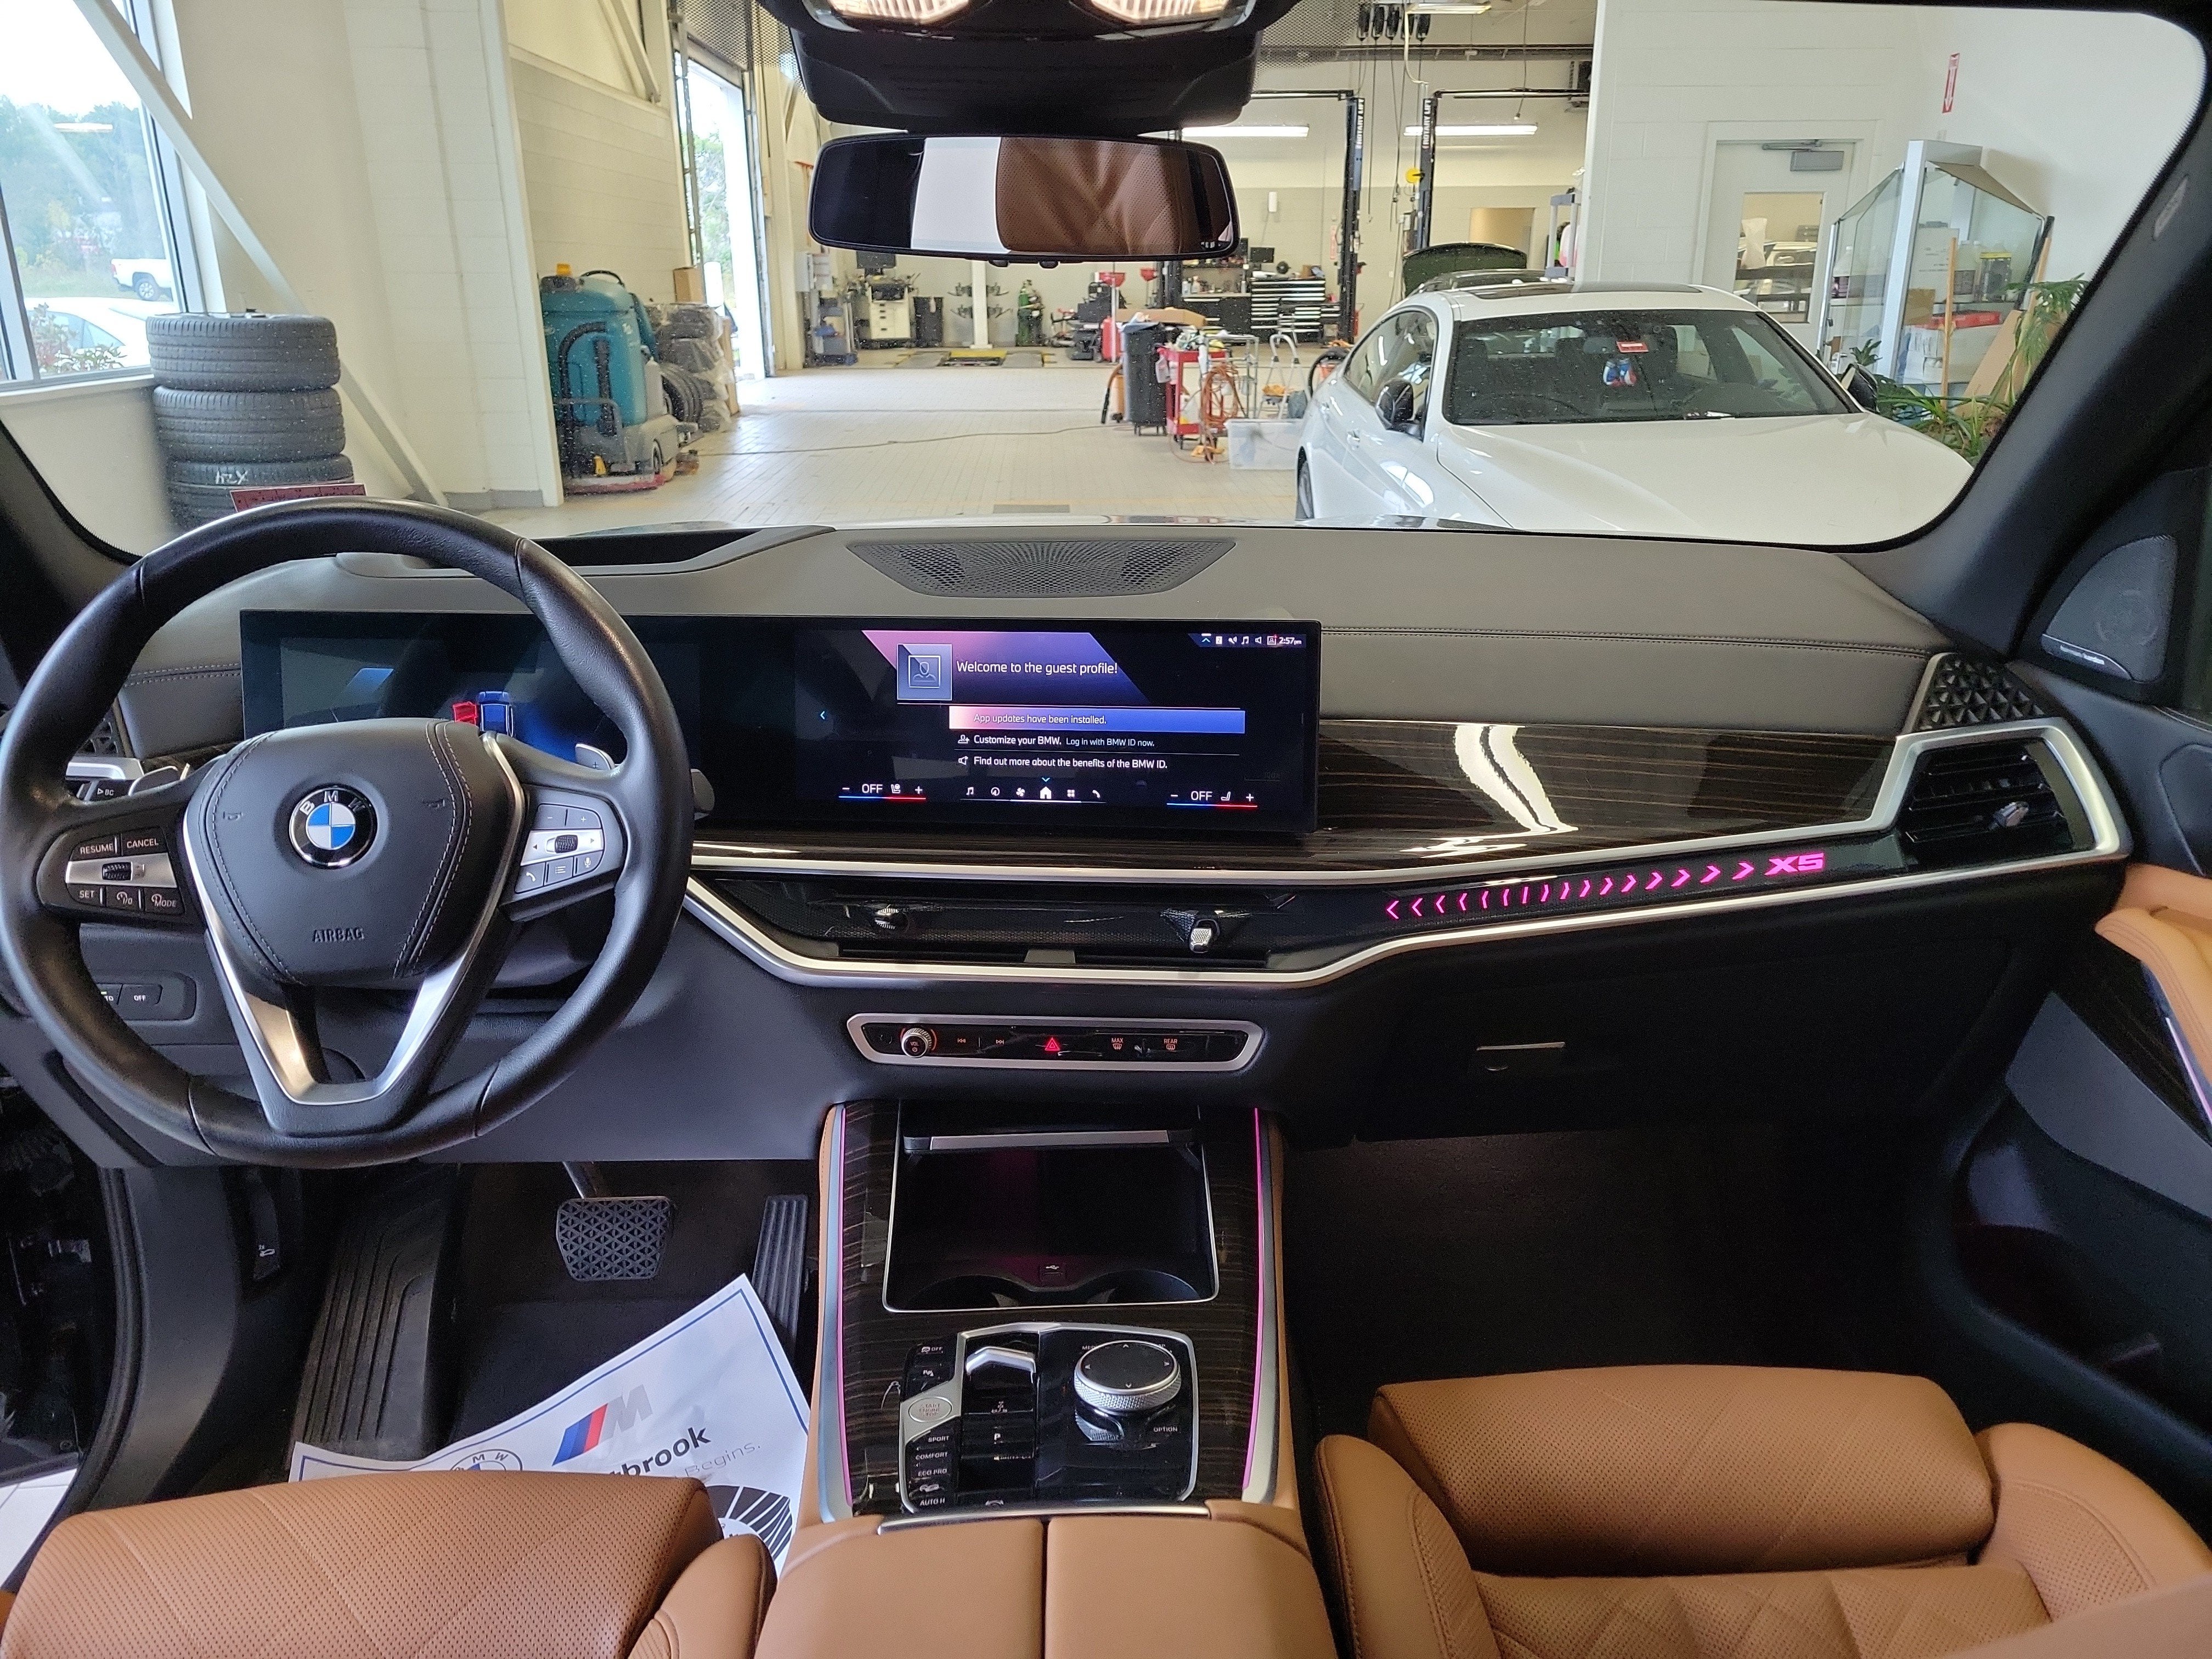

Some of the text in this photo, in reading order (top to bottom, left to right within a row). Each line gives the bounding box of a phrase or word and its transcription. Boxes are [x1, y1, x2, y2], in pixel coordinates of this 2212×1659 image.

[1423, 115, 1431, 145] ROTARY
[956, 661, 1118, 676] Welcome to the guest profile!
[973, 714, 1107, 724] App updates have been installed.
[973, 735, 1016, 745] Customize
[1018, 737, 1036, 747] your
[1037, 736, 1062, 746] BMW.
[1066, 737, 1080, 747] Log
[1090, 737, 1105, 746] with
[1107, 738, 1126, 747] BMW
[1127, 738, 1136, 747] ID
[974, 757, 992, 766] Find
[994, 758, 1007, 766] out
[1032, 757, 1056, 767] about
[1057, 758, 1071, 767] the
[1073, 758, 1105, 768] benefits
[1107, 759, 1115, 768] of
[1116, 759, 1130, 768] the
[1132, 760, 1154, 769] BMW
[1156, 760, 1167, 769] ID.
[861, 783, 883, 793] OFF
[1190, 791, 1213, 801] OFF
[300, 790, 365, 815] BMW
[80, 843, 113, 854] RESUME
[126, 838, 159, 849] CANCEL
[1764, 852, 1824, 876] X5
[79, 890, 95, 898] SET
[312, 927, 365, 944] AIRBAG
[610, 1426, 712, 1476] brook
[915, 1451, 948, 1460] COMFORT
[684, 1444, 761, 1477] Begins.
[919, 1498, 939, 1506] AUTO
